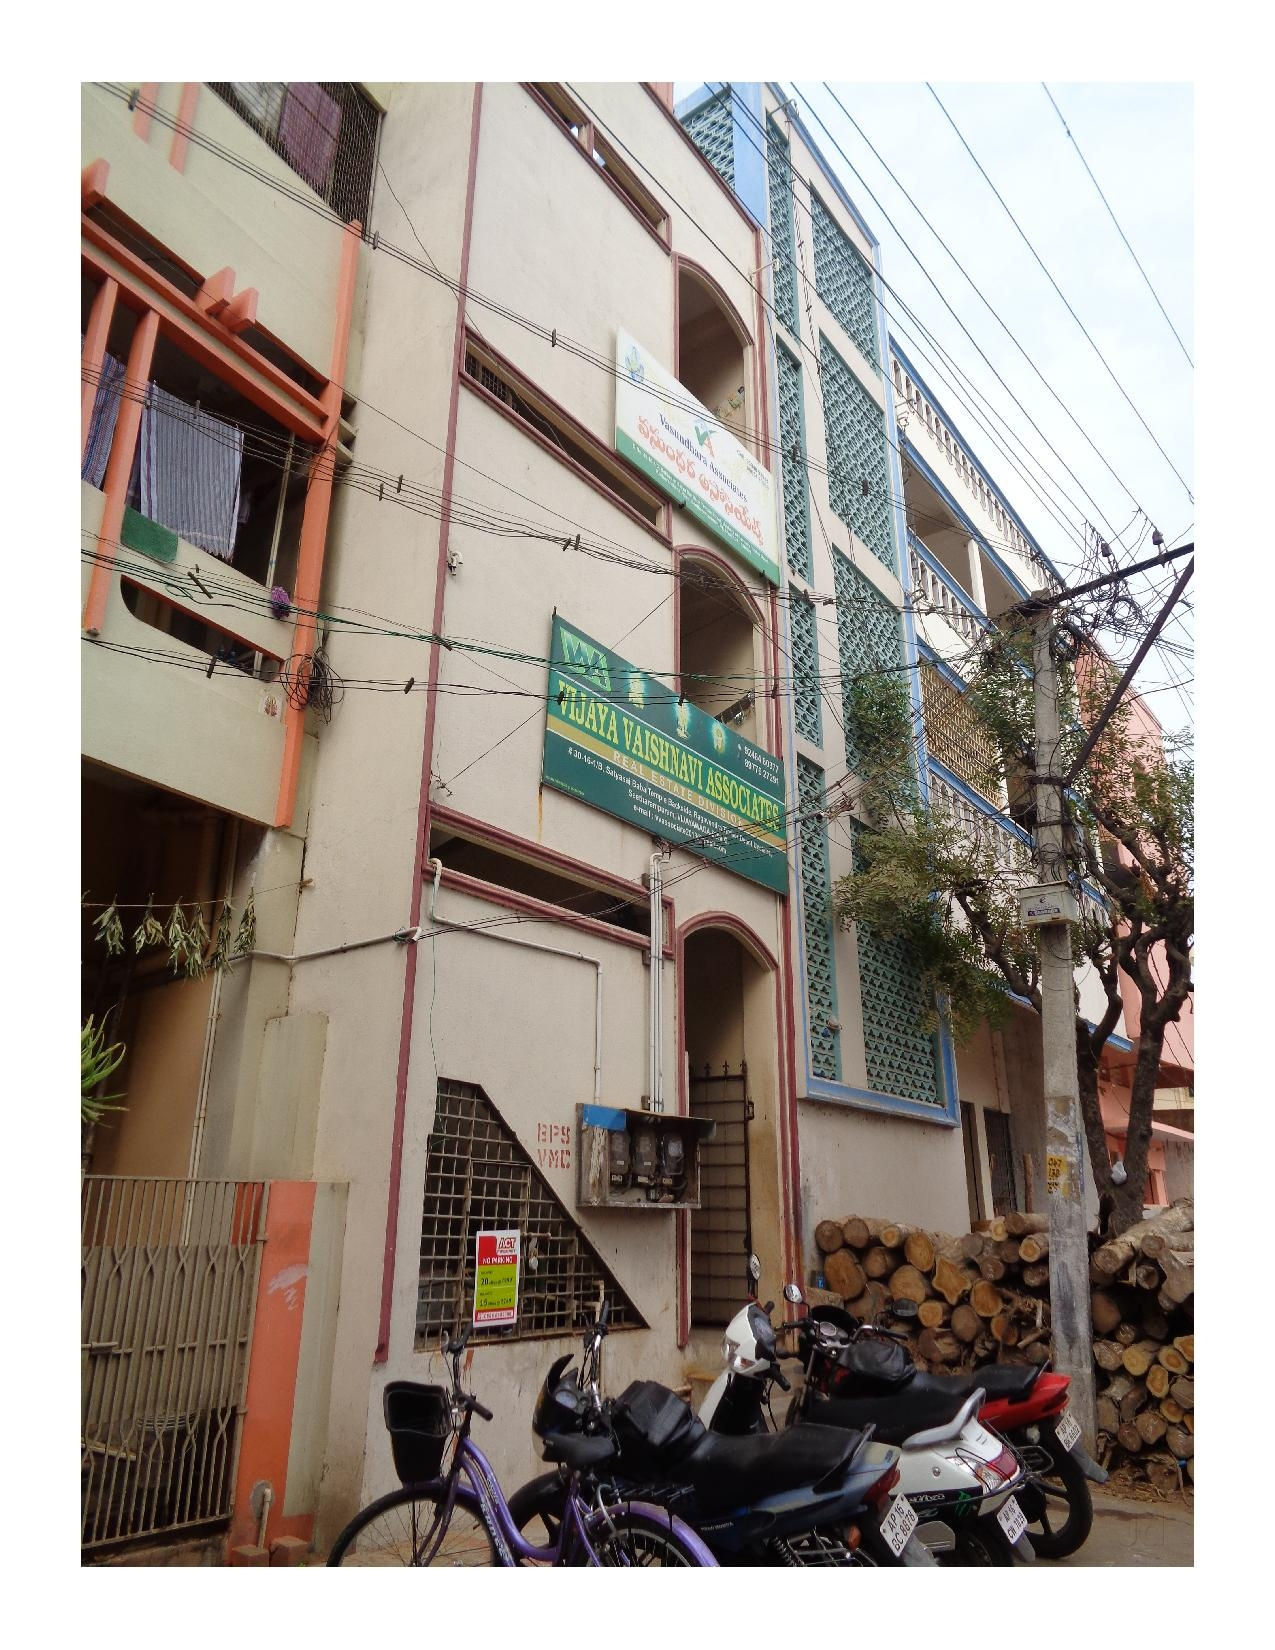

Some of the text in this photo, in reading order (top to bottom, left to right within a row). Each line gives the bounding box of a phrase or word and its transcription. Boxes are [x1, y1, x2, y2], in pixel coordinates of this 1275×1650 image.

[659, 411, 709, 467] Vasundhara
[709, 460, 748, 503] Associates
[559, 679, 780, 832] VIJAYA VAISHNAVI ASSOCIATES
[605, 764, 631, 787] Satyasai
[631, 778, 647, 794] Baba
[613, 750, 743, 828] REAL ESTATE DIVISION
[538, 1149, 571, 1169] VMC
[498, 1237, 516, 1249] ACT
[482, 1256, 491, 1264] NO
[887, 1503, 905, 1533] AP 16
[891, 1532, 904, 1551] BC
